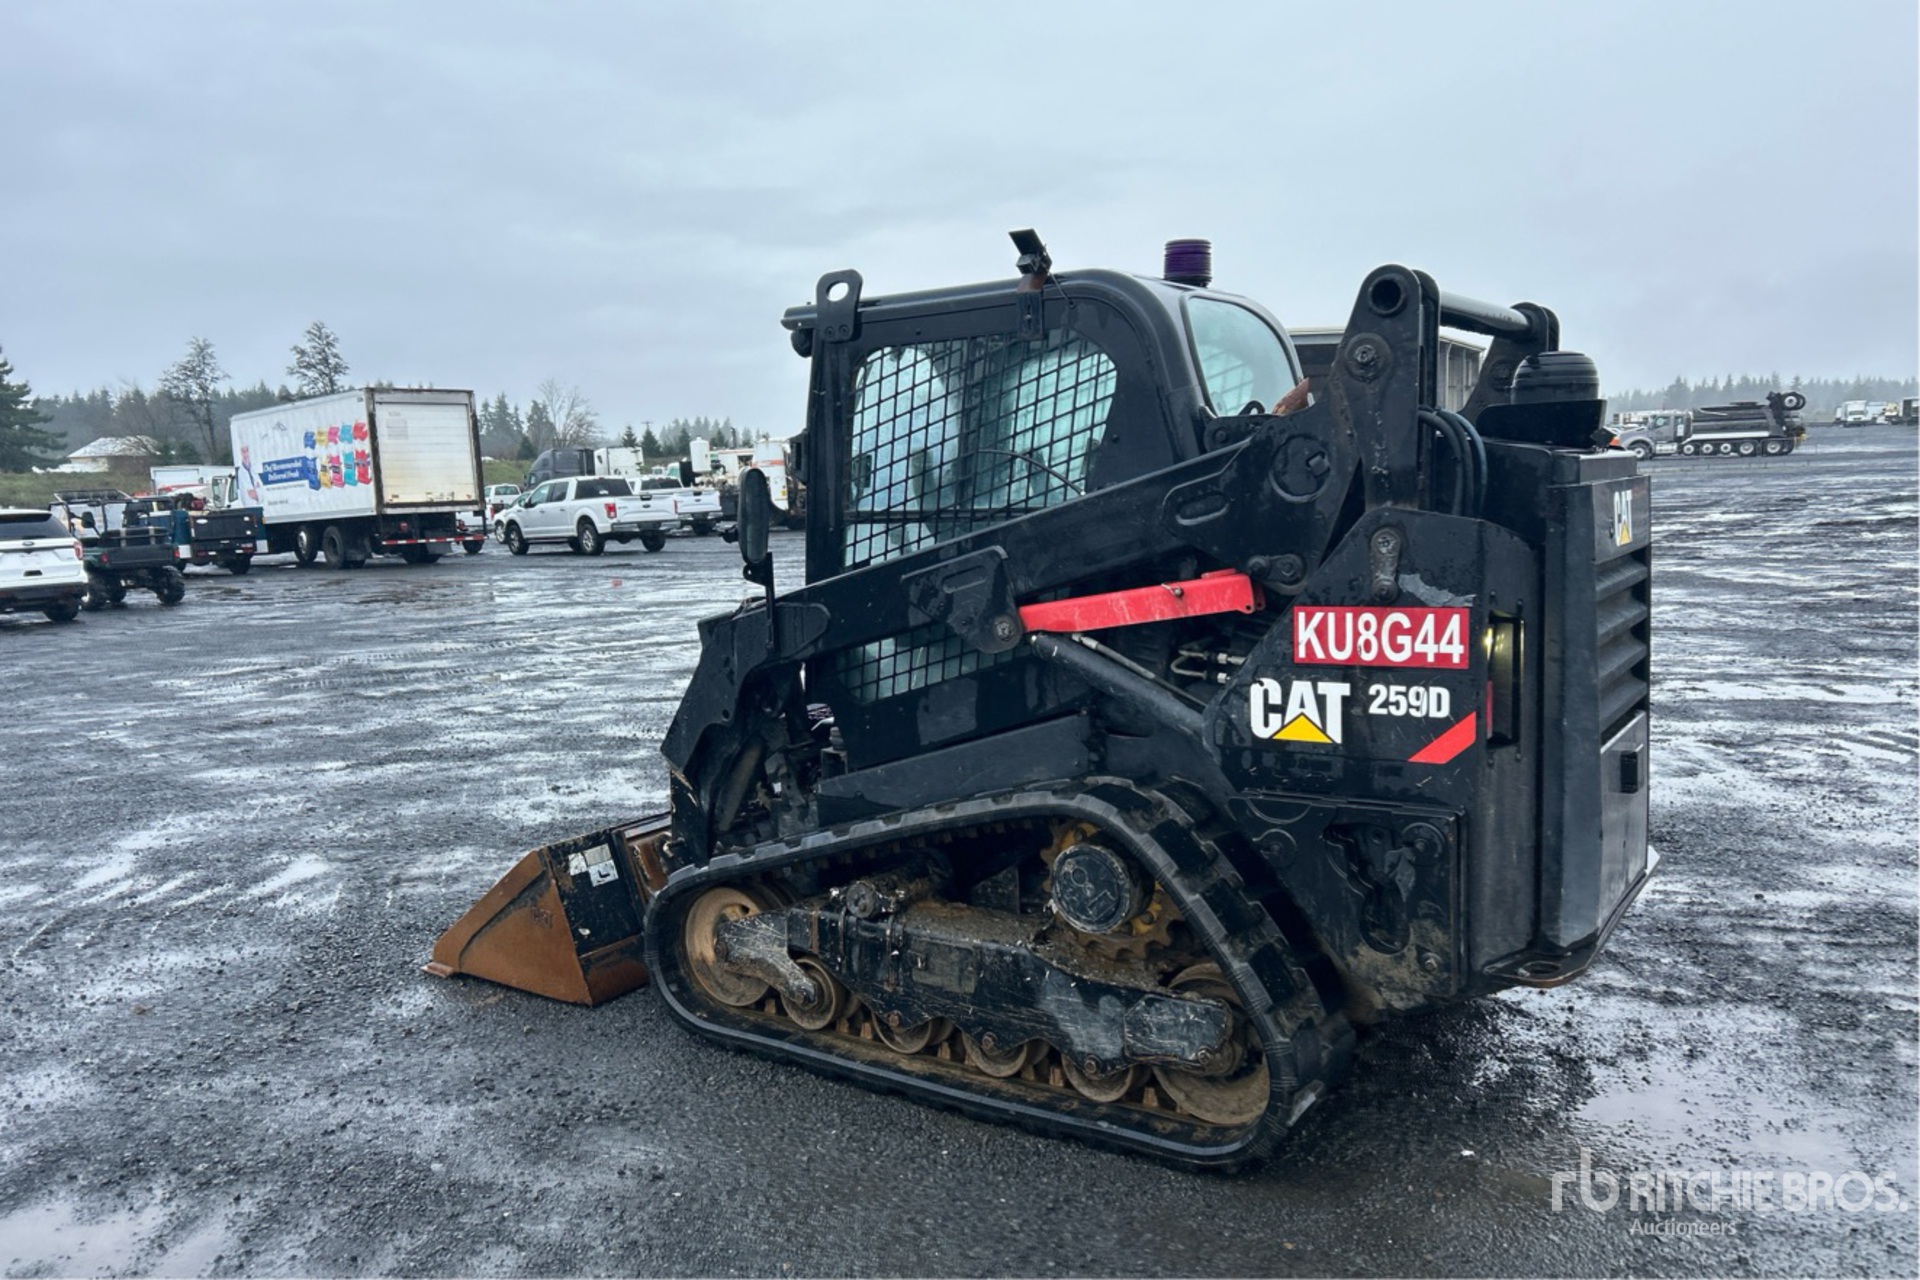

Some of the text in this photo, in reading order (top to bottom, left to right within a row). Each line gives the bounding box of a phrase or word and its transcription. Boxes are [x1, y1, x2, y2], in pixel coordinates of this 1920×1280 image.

[1614, 489, 1632, 546] CAT
[1297, 611, 1465, 664] KU8G44
[1250, 677, 1451, 745] CAT 259D
